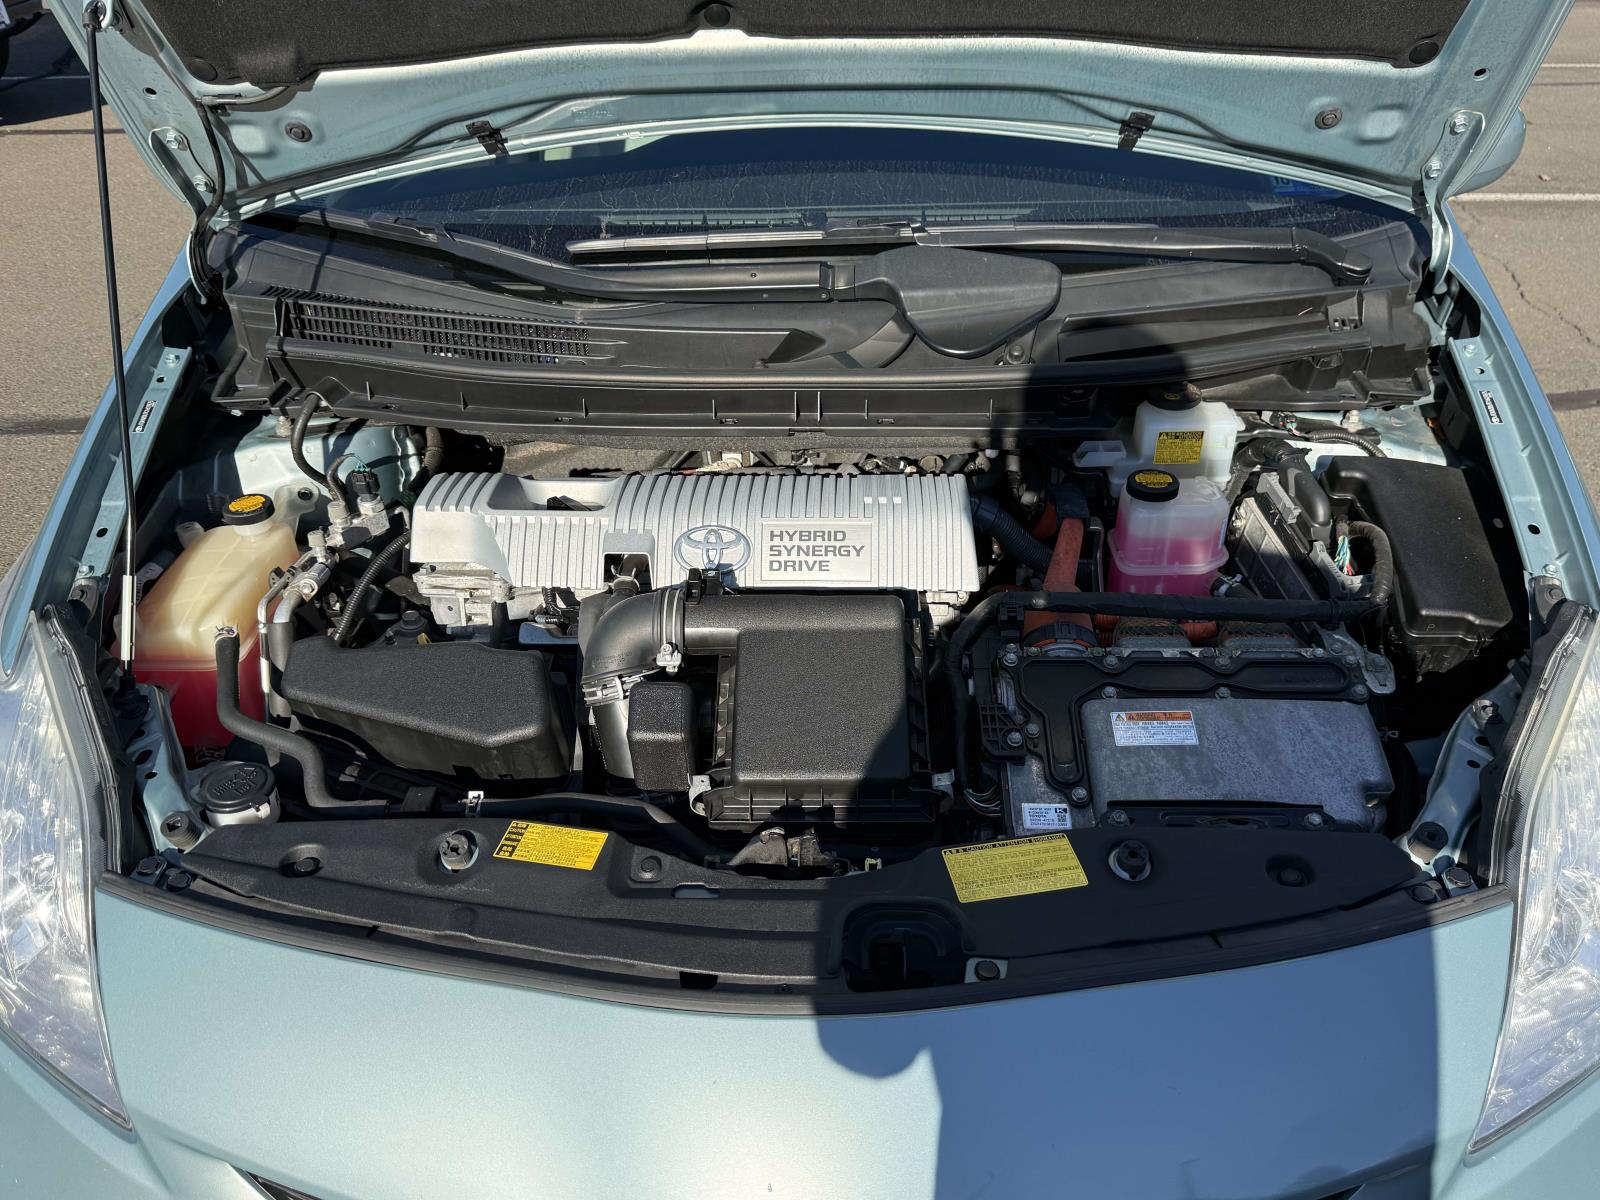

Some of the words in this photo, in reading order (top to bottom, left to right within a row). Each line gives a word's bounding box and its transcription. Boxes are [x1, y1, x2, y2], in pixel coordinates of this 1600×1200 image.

[769, 530, 847, 542] HYBRID
[769, 545, 865, 557] SYNERGY
[769, 560, 830, 572] DRIVE
[966, 843, 993, 852] CAUTION
[996, 839, 1029, 848] ATTENTION
